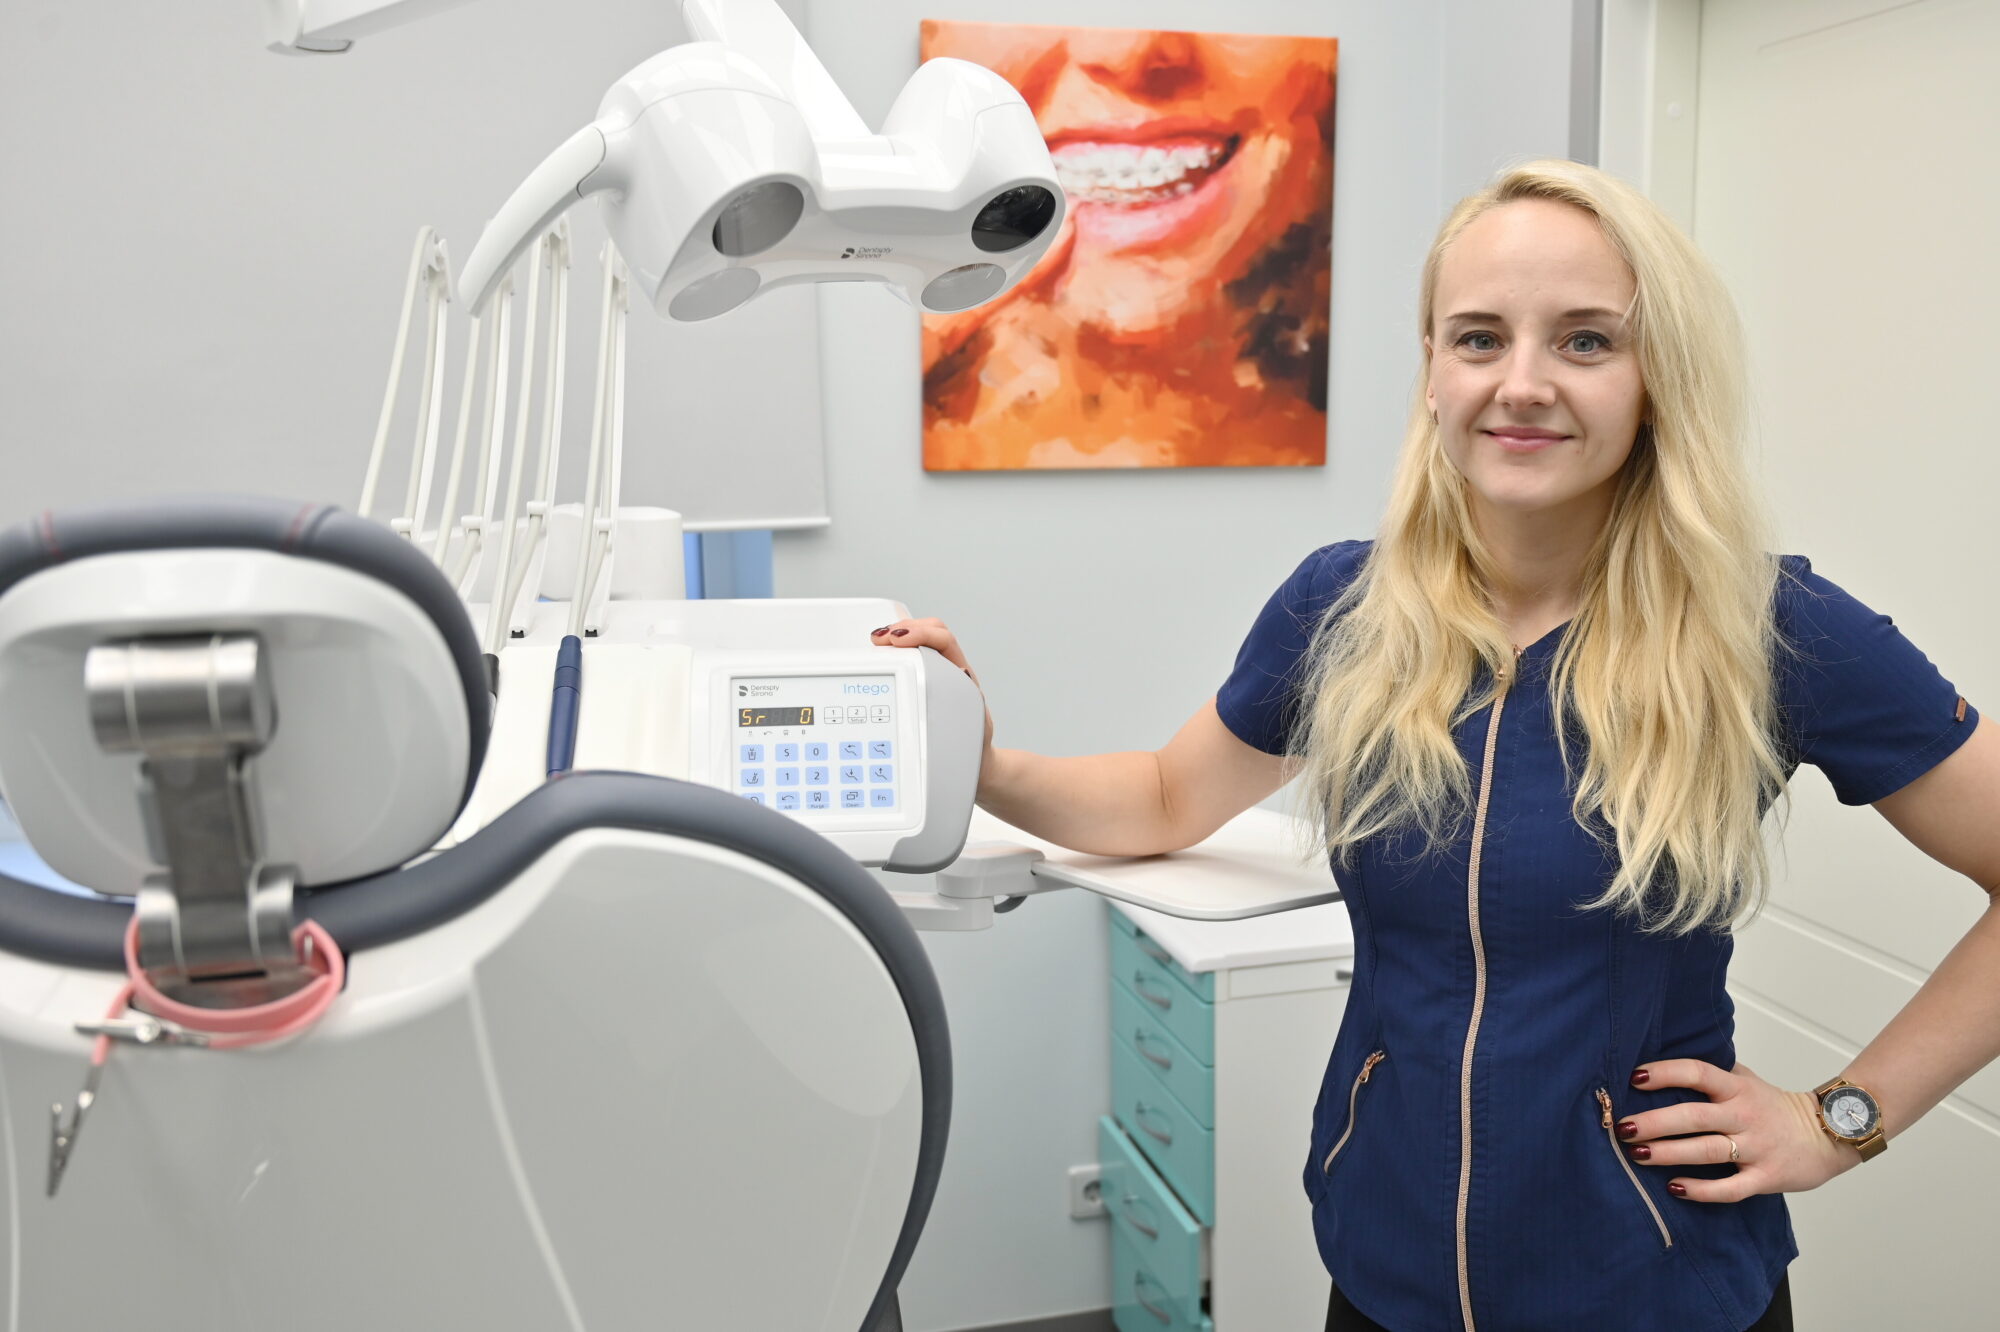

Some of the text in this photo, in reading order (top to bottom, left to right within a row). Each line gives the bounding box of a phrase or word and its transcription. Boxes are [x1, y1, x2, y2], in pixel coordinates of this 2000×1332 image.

[843, 684, 890, 695] Intego
[800, 708, 811, 724] 0
[812, 747, 819, 756] 0
[814, 771, 820, 780] 2
